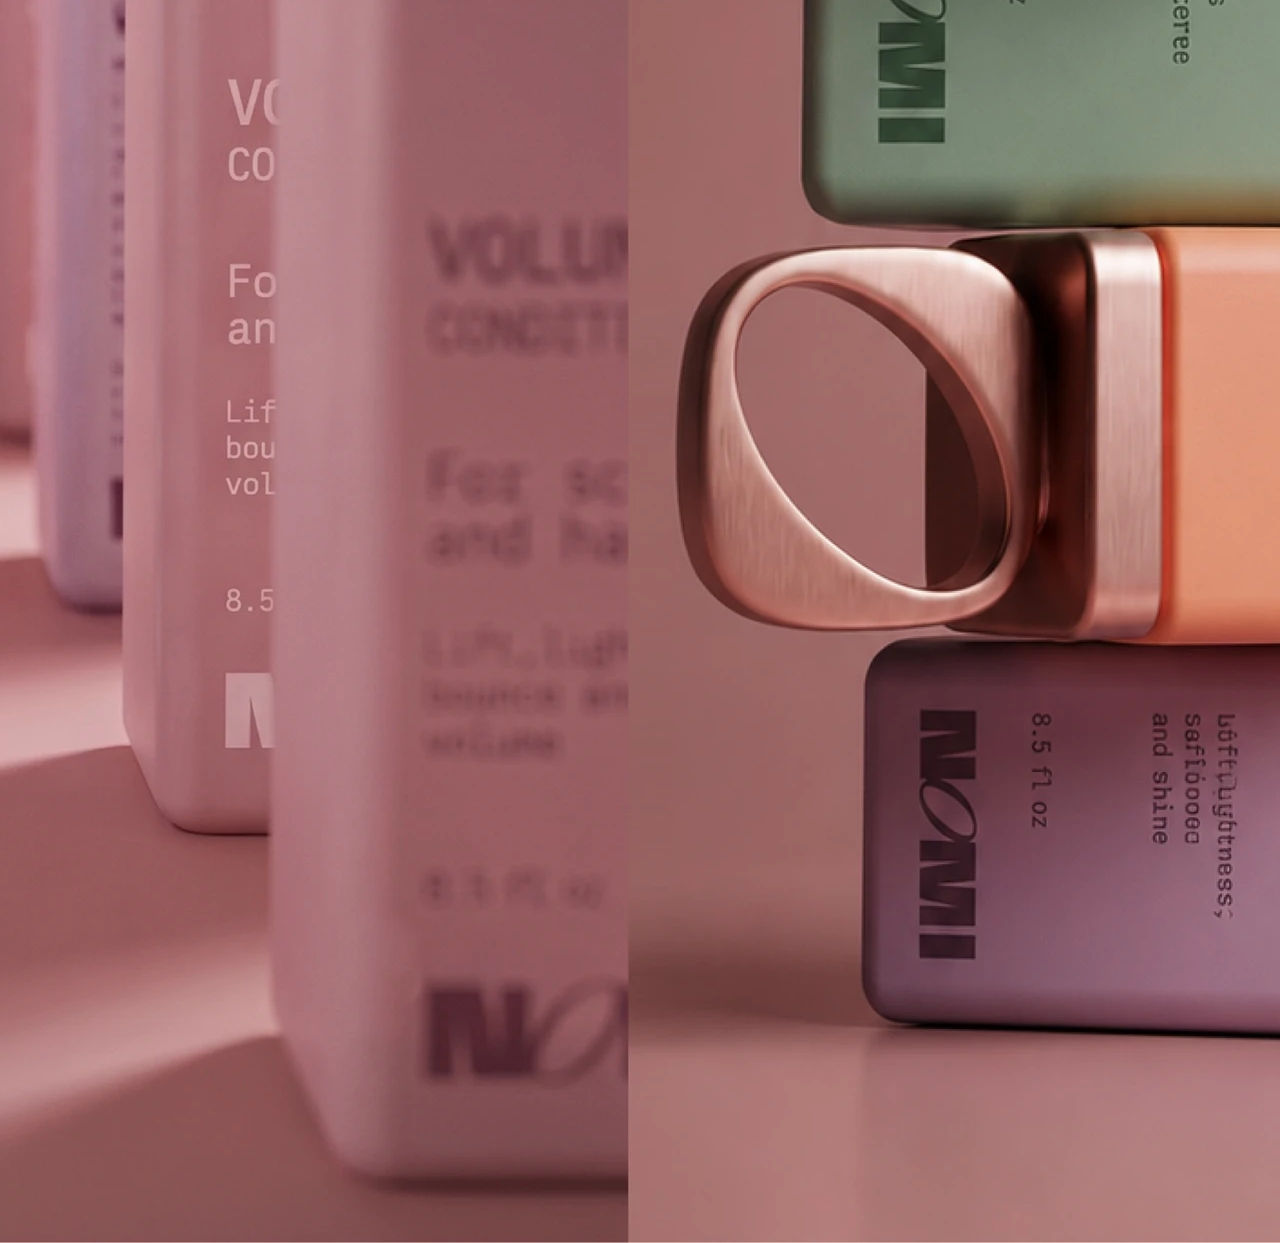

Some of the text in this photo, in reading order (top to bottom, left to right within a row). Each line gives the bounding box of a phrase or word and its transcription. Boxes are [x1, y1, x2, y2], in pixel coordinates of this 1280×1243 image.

[1031, 712, 1053, 828] 8.5 fl oz
[1151, 712, 1174, 845] and shine
[918, 709, 977, 960] NOMI
[427, 978, 628, 1084] NO
